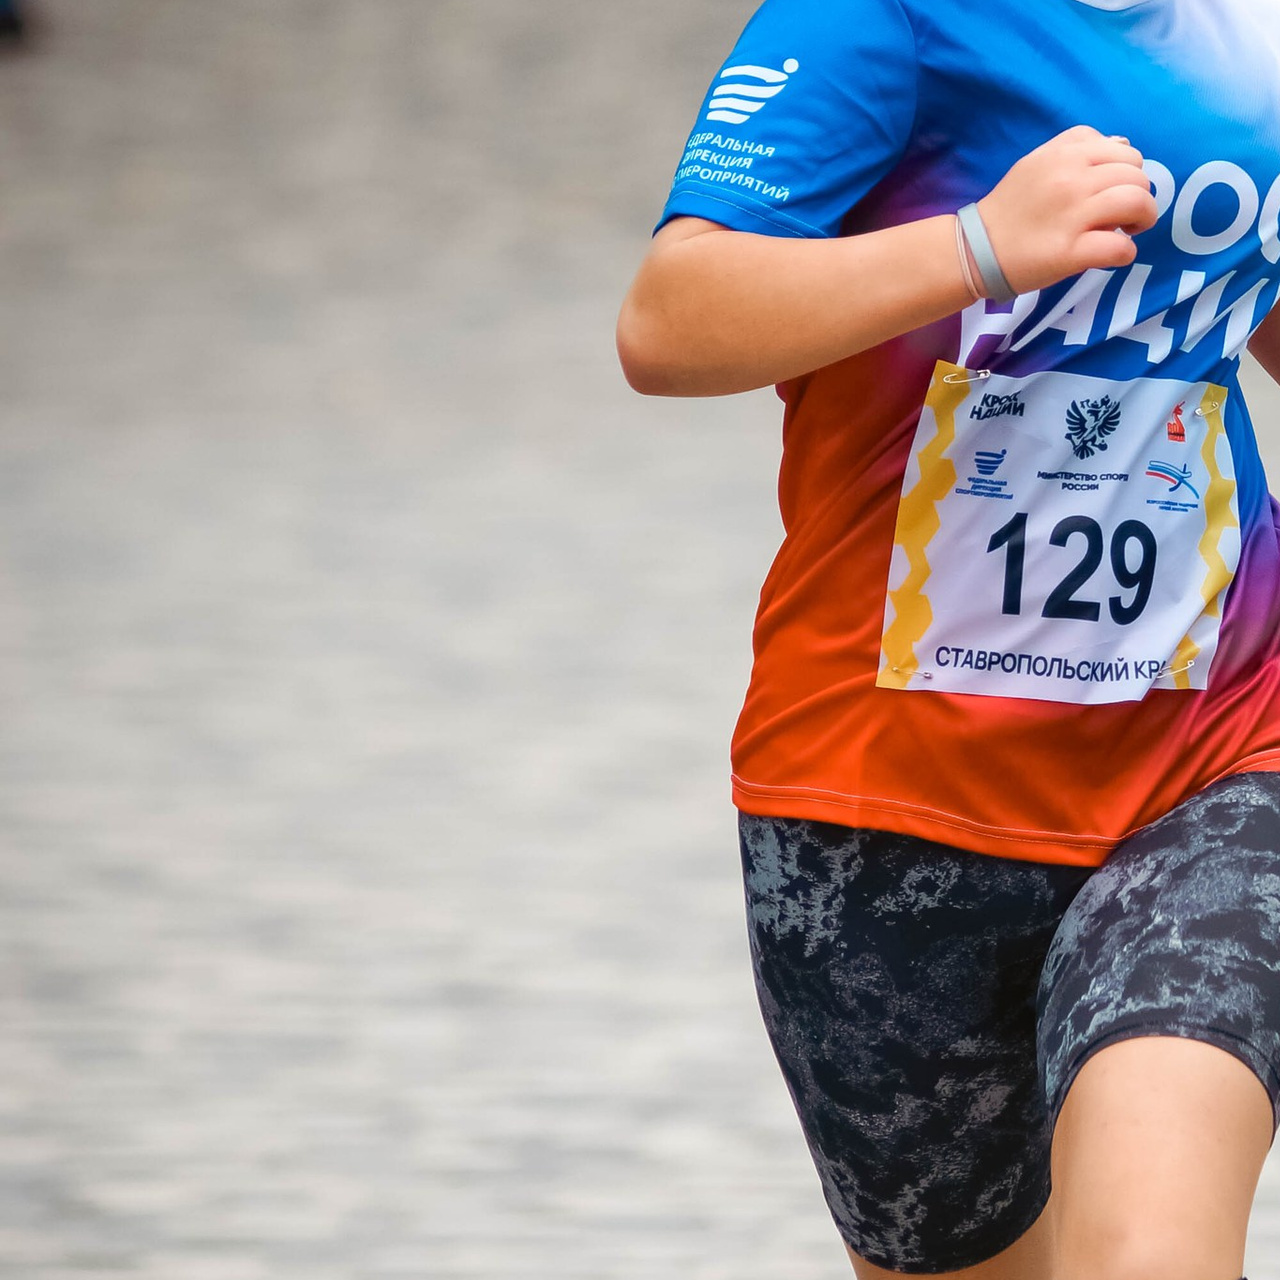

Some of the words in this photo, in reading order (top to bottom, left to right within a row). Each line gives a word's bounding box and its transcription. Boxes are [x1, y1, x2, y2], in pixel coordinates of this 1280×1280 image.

[969, 402, 1025, 421] НАЦИИ
[1061, 482, 1099, 491] РОССИИ
[986, 511, 1158, 626] 129
[935, 645, 1130, 682] СТАВРОПОЛЬСКИЙ
